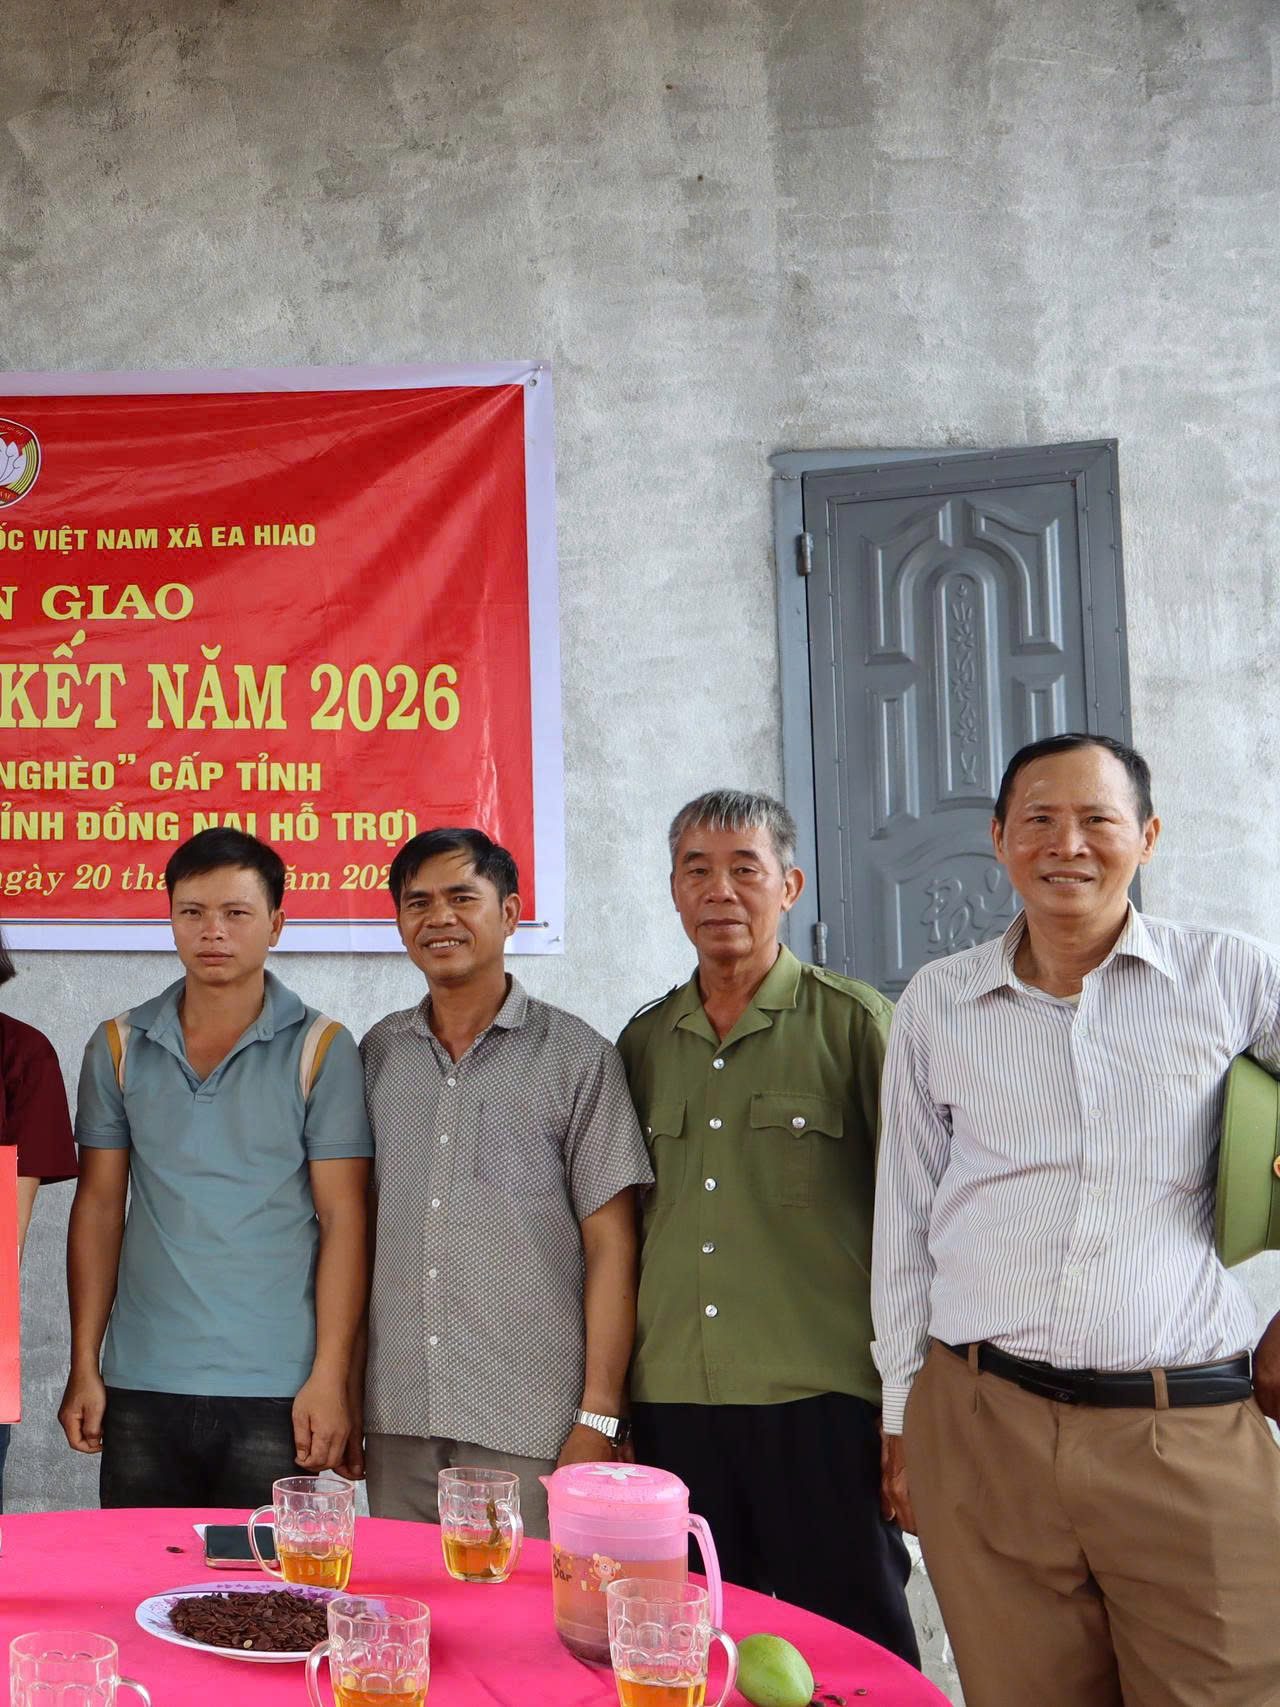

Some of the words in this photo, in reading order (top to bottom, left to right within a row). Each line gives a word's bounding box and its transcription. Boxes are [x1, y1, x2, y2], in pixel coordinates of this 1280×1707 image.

[33, 525, 89, 555] VIỆT
[96, 528, 158, 550] NAM
[167, 523, 203, 548] XÃ
[211, 526, 246, 547] EA
[254, 523, 316, 545] HIAO
[41, 583, 195, 621] GIAO
[146, 643, 288, 730] NĂM
[310, 663, 461, 733] 2026
[149, 751, 224, 791] CẤP
[235, 751, 322, 792] TỈNH
[76, 801, 180, 841] ĐỒNG
[269, 801, 320, 842] HỖ
[331, 808, 417, 848] TRỢ)
[72, 863, 112, 890] 20
[283, 864, 331, 891] ăm
[339, 863, 392, 891] 202
